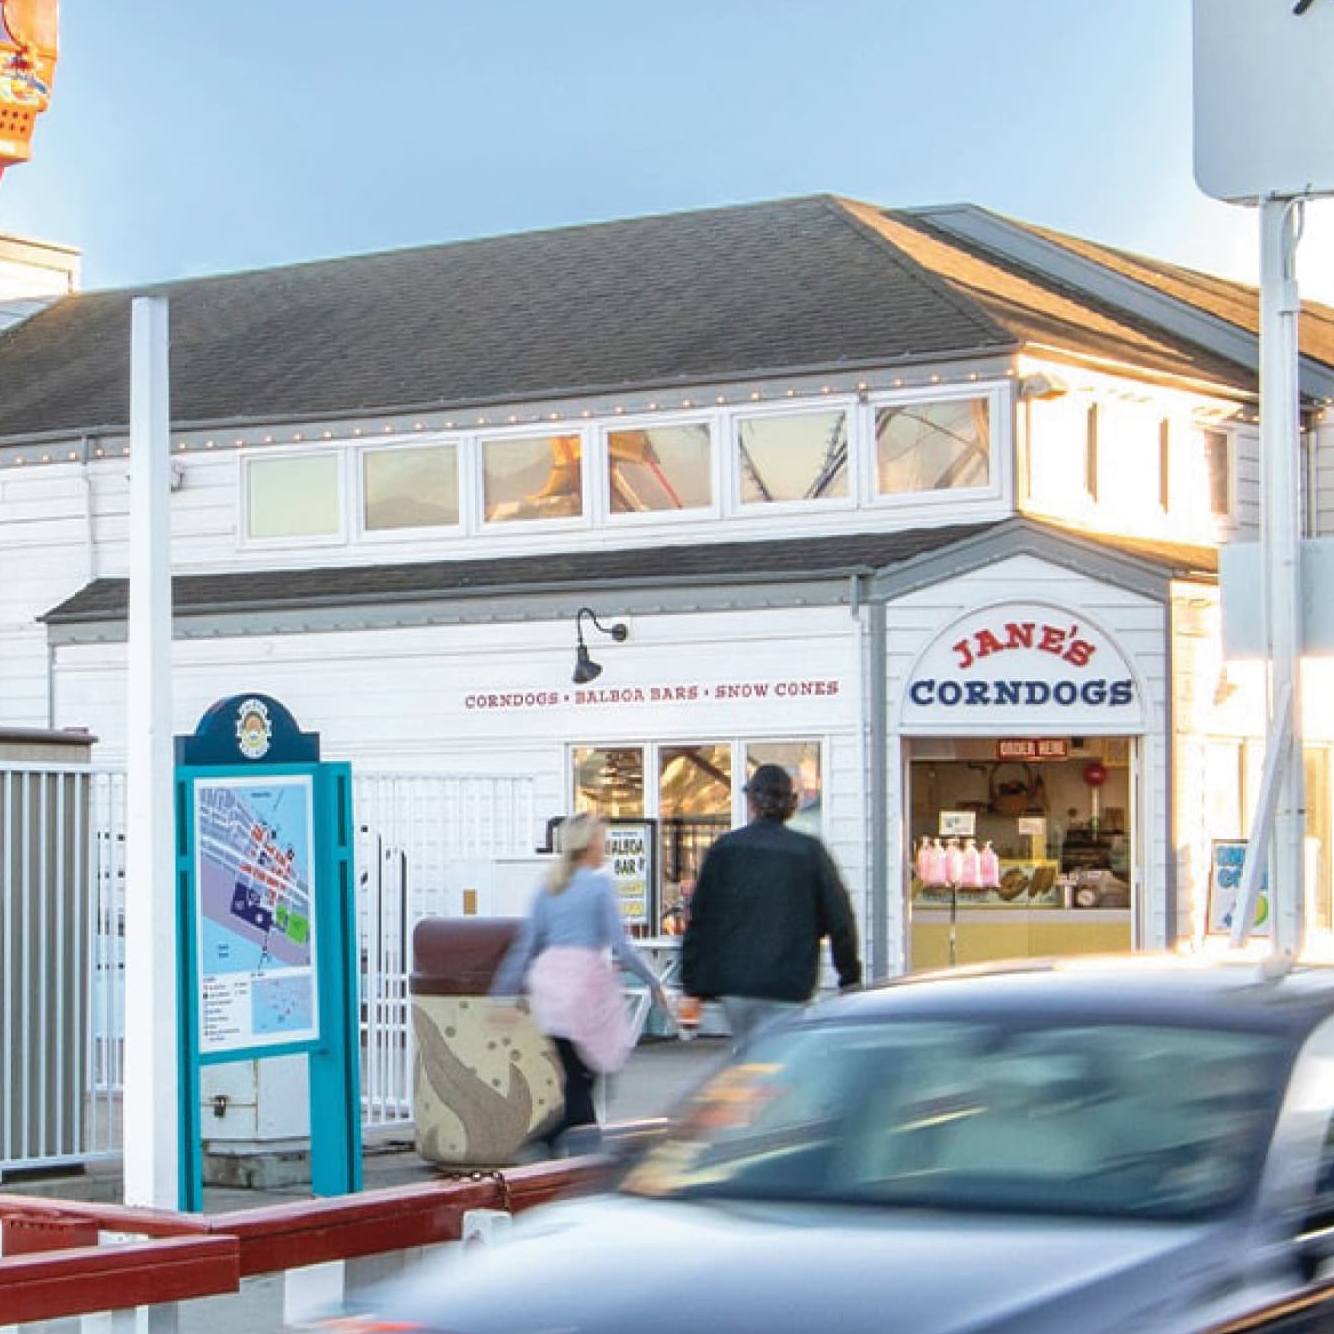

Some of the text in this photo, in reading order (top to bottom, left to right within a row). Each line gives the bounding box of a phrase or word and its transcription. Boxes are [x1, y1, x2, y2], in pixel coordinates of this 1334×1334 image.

[952, 622, 1097, 669] JANE'S
[465, 680, 840, 709] CORNDOGS BALBOA BARS SNOW CONES
[910, 677, 1133, 707] CORNDOGS
